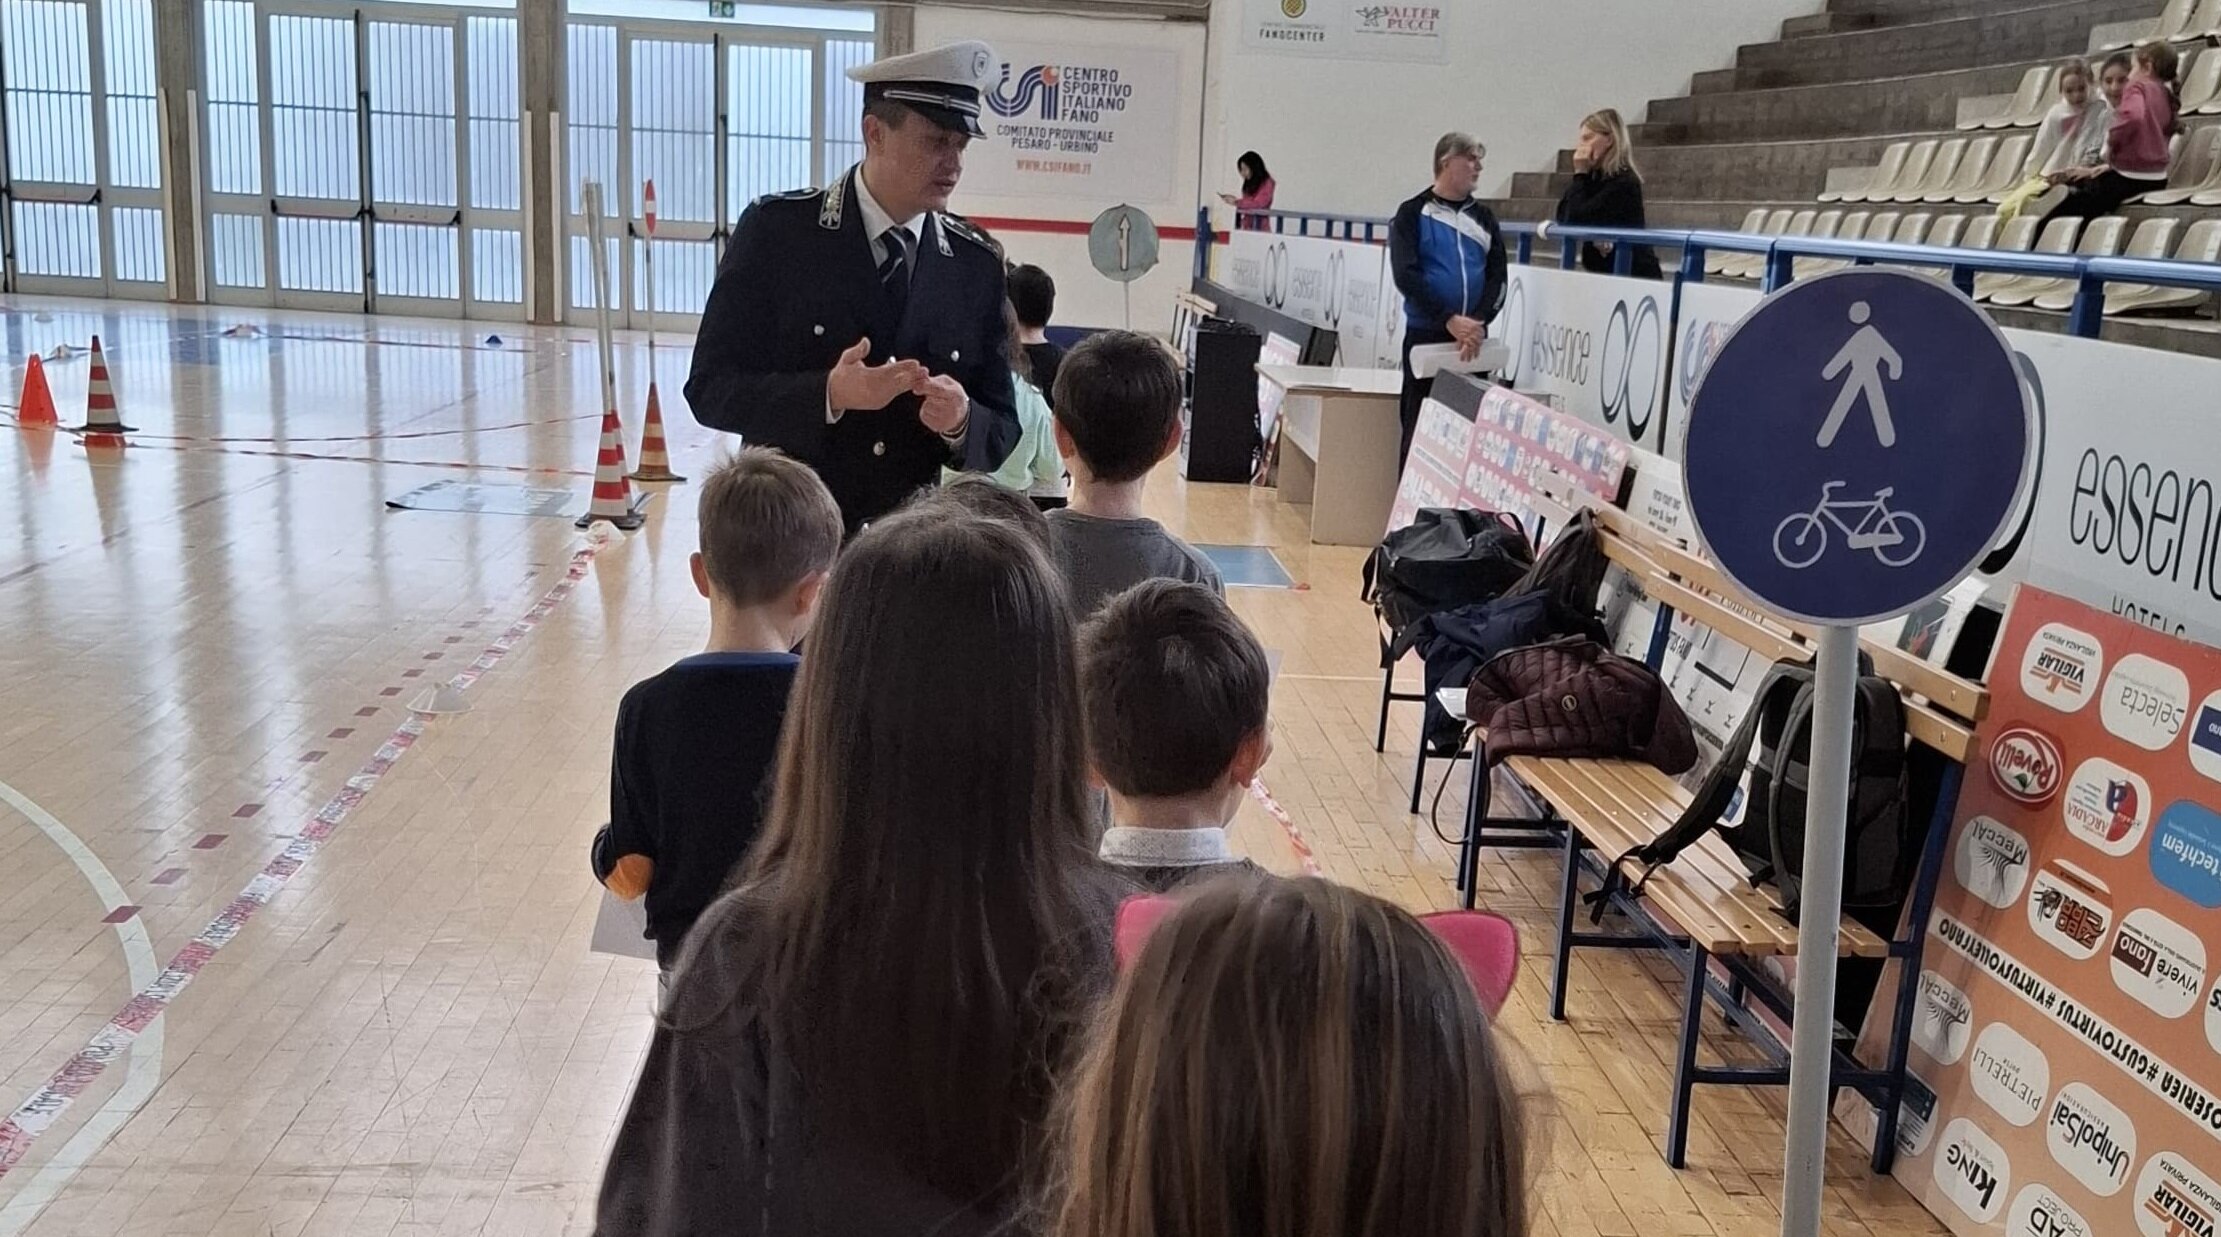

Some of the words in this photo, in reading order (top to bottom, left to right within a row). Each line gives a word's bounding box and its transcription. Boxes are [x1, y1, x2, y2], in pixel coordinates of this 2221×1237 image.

[1259, 28, 1325, 42] FANOCENTER
[1387, 18, 1435, 31] PUCCI
[1062, 81, 1132, 97] SPORTIVO
[1063, 66, 1119, 82] CENTRO
[1061, 109, 1099, 123] FANO
[1062, 95, 1125, 111] ITALIANO
[997, 124, 1046, 138] COMITATO
[1050, 127, 1114, 143] PROVINCIALE
[1011, 137, 1050, 150] PESARO
[1059, 140, 1099, 154] URBINO
[1531, 321, 1590, 386] essence
[2037, 652, 2084, 683] VIGILAR
[2120, 686, 2185, 735] Selecta
[1998, 742, 2055, 789] Rovelli
[2067, 802, 2108, 833] ARCADIA
[2162, 833, 2219, 875] techfem
[1939, 919, 2056, 1010] #VIRTUSVOLLEYFANO
[2120, 936, 2153, 972] fano
[2157, 959, 2198, 996] vivere
[2056, 1000, 2160, 1082] #GUSTOVIRTUS
[1973, 1047, 2043, 1112] PIETRELLI
[2050, 1100, 2130, 1185] UnipolSai
[2160, 1158, 2189, 1185] PRIVATA
[2154, 1184, 2214, 1237] VIGILAR
[2189, 1181, 2221, 1213] GILANZA
[2037, 1194, 2083, 1237] PROJECT
